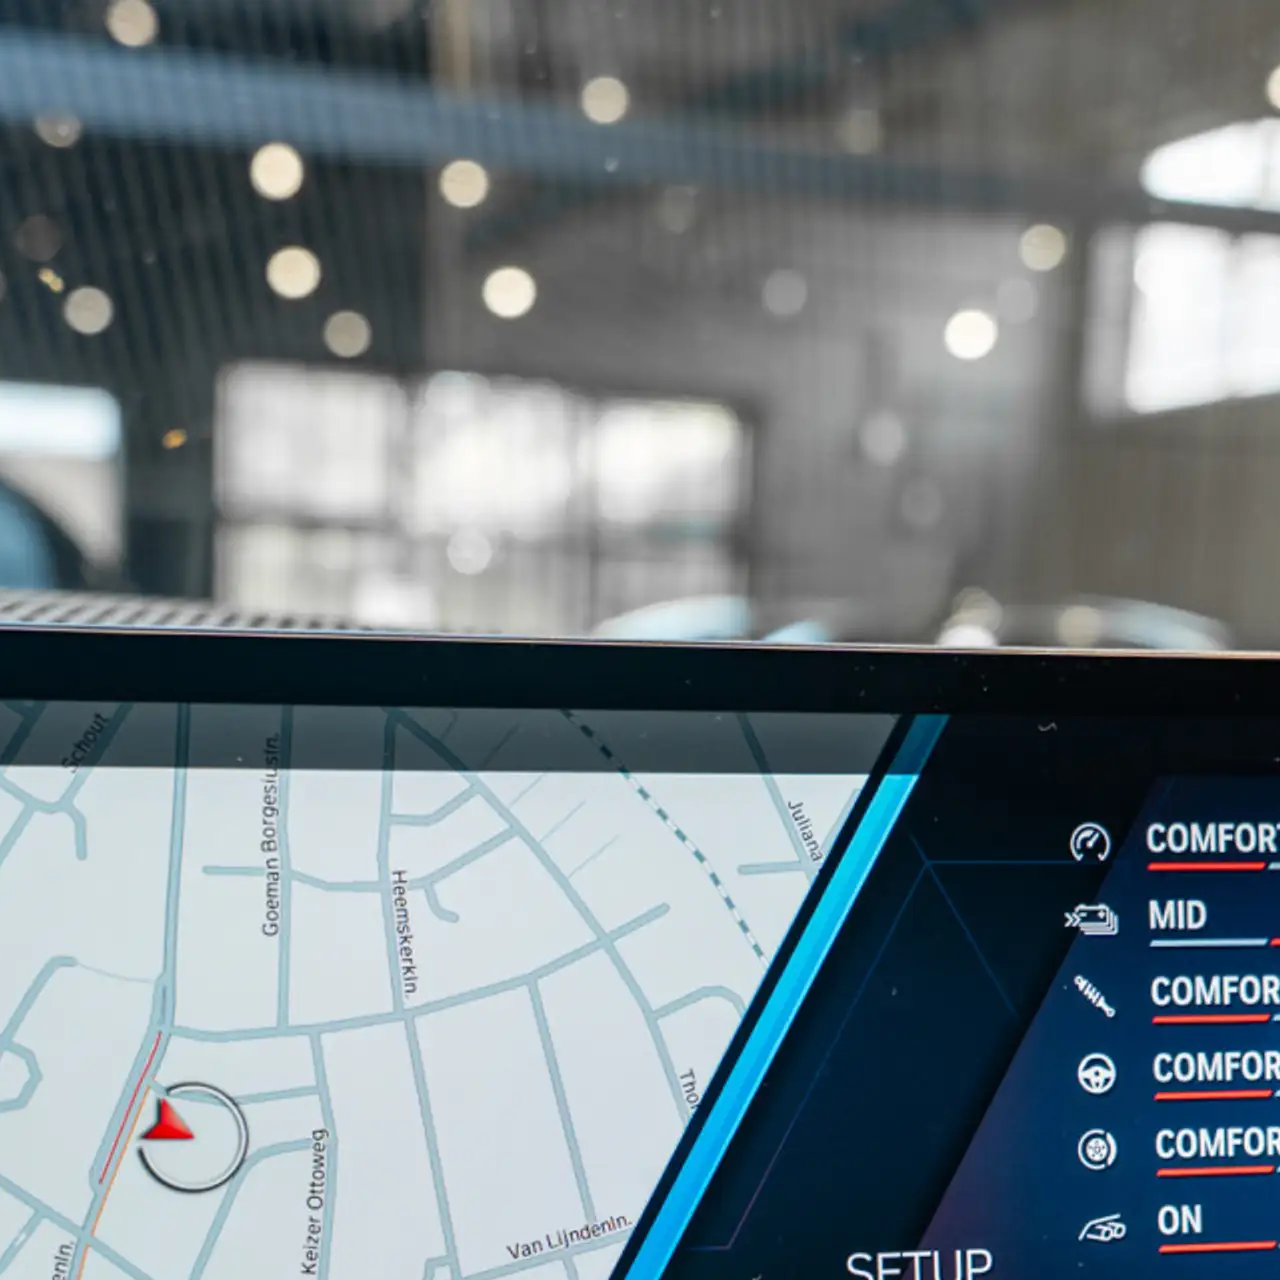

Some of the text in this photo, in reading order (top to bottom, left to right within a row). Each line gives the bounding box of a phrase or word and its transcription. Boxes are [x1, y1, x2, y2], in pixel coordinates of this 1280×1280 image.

[61, 713, 109, 774] Schout
[787, 800, 824, 862] Juliana
[261, 857, 280, 937] Goeman
[1148, 899, 1208, 930] MID
[300, 1127, 329, 1276] Keizer Ottoweg
[1157, 1204, 1202, 1235] ON
[506, 1239, 544, 1260] Van
